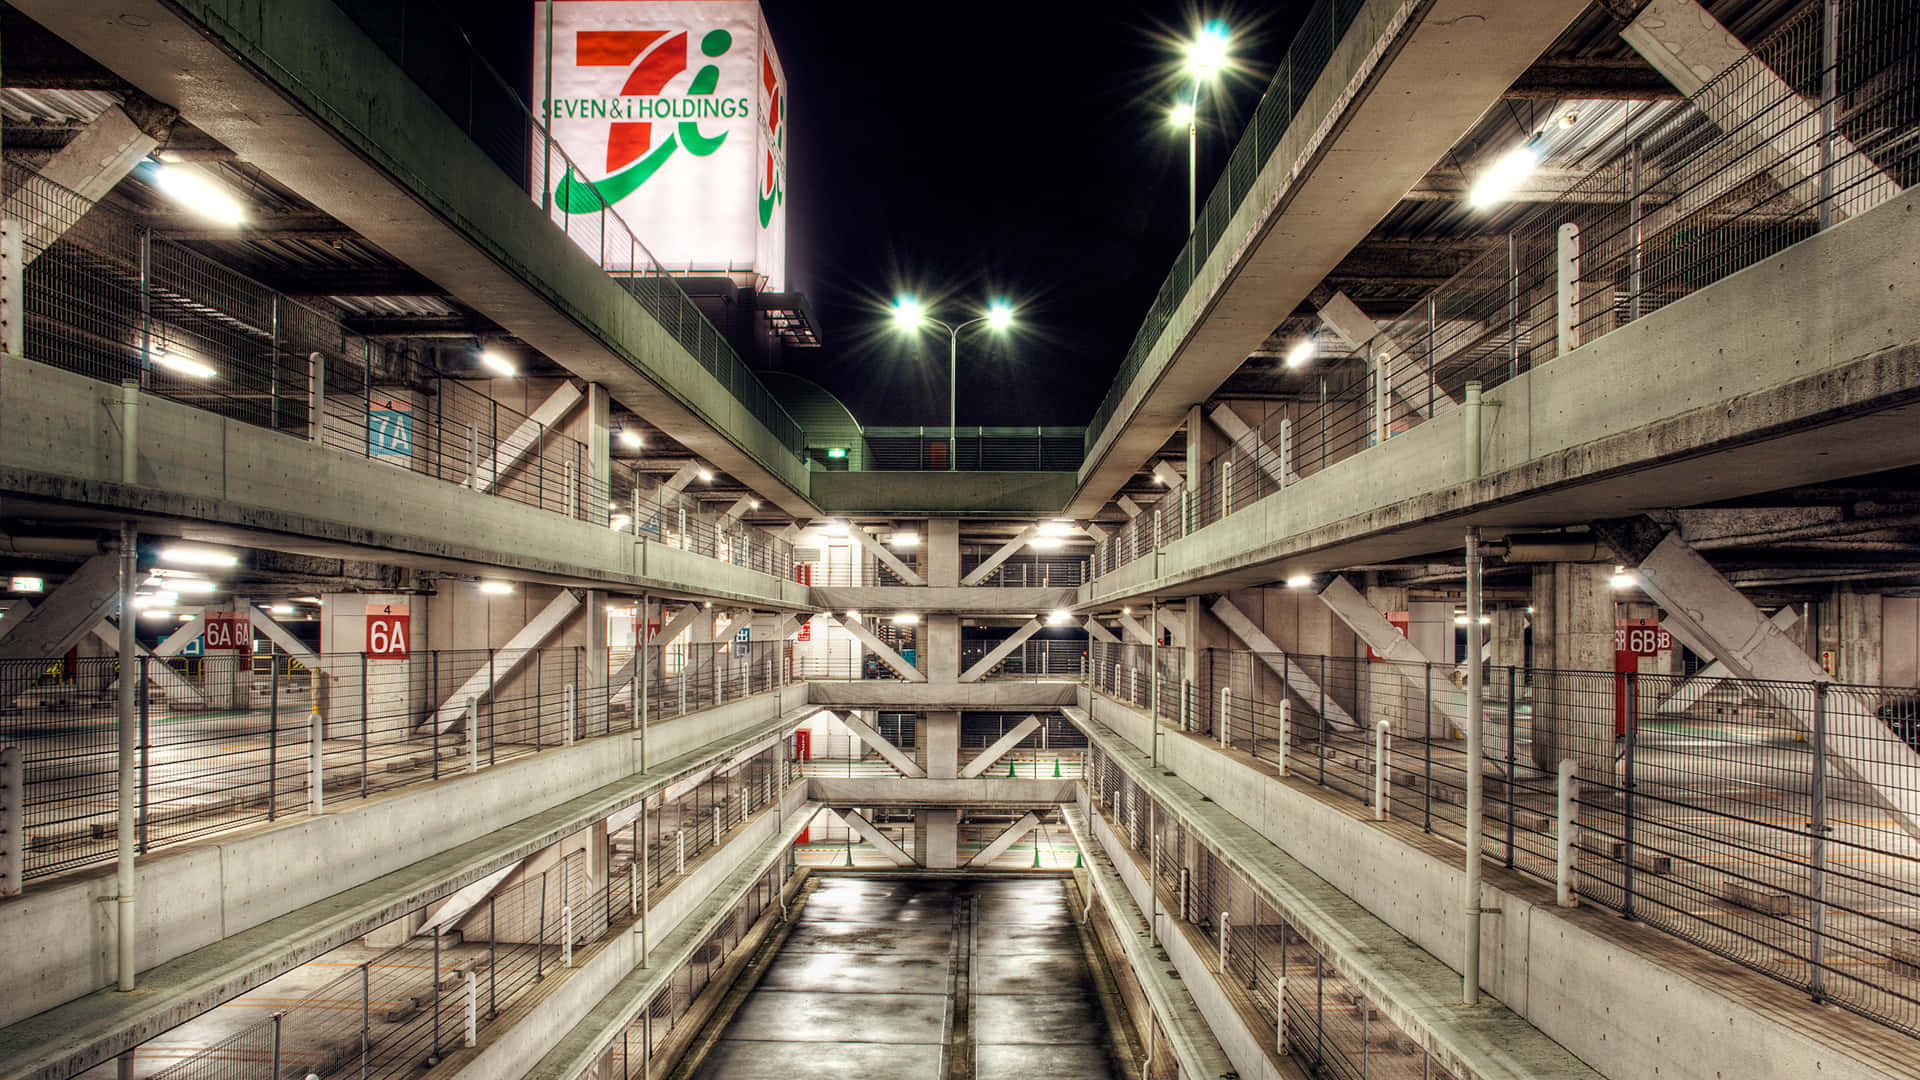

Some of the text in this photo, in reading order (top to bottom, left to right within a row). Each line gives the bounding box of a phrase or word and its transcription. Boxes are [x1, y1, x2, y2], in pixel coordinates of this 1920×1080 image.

[639, 97, 749, 119] HOLDINGS
[371, 415, 409, 449] 7A
[383, 605, 391, 614] 4
[207, 622, 232, 646] 6A
[235, 622, 250, 645] 6A
[370, 620, 406, 654] 6A
[1630, 630, 1656, 653] 6B
